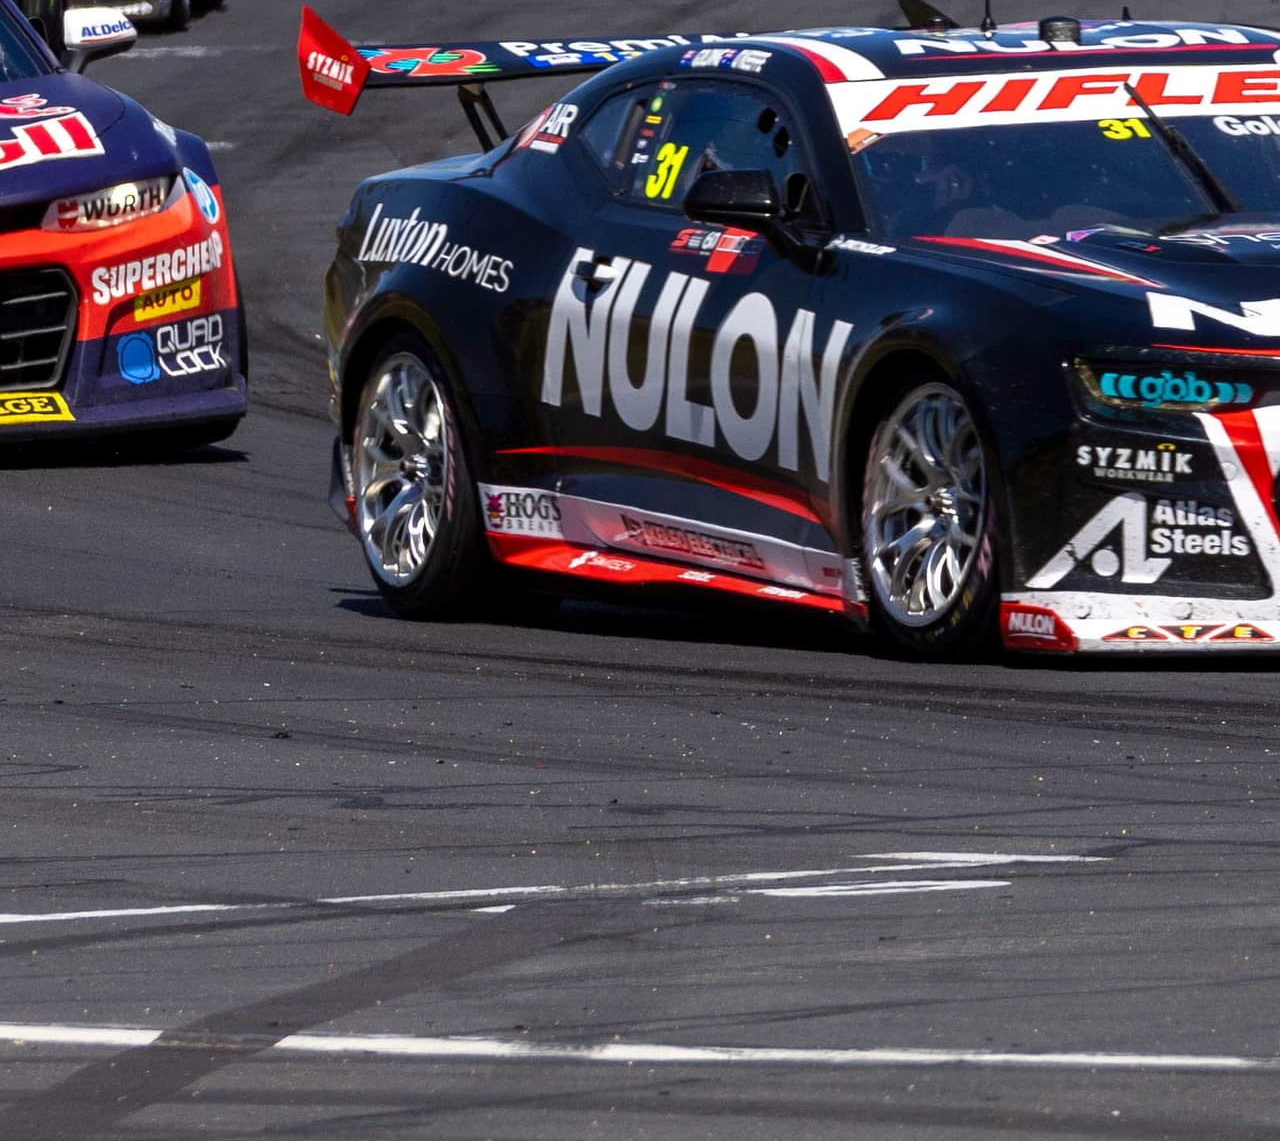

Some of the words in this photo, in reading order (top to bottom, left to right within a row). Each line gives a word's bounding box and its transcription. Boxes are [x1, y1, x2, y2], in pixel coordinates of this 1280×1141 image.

[892, 27, 1252, 56] NULON
[1097, 118, 1153, 141] 31
[645, 142, 691, 201] 31
[358, 202, 449, 268] Luxton
[437, 236, 515, 294] HOMES
[91, 230, 224, 306] SUPERCHEAP
[140, 283, 194, 312] AUTO
[156, 314, 223, 354] QUAD
[158, 342, 227, 377] LOCK
[541, 246, 855, 484] NULON
[1076, 443, 1194, 476] SYZMIK
[1093, 467, 1175, 483] WORKWEAR
[1151, 498, 1235, 527] Atlas
[1150, 527, 1251, 557] Steels
[1008, 612, 1056, 636] NULON
